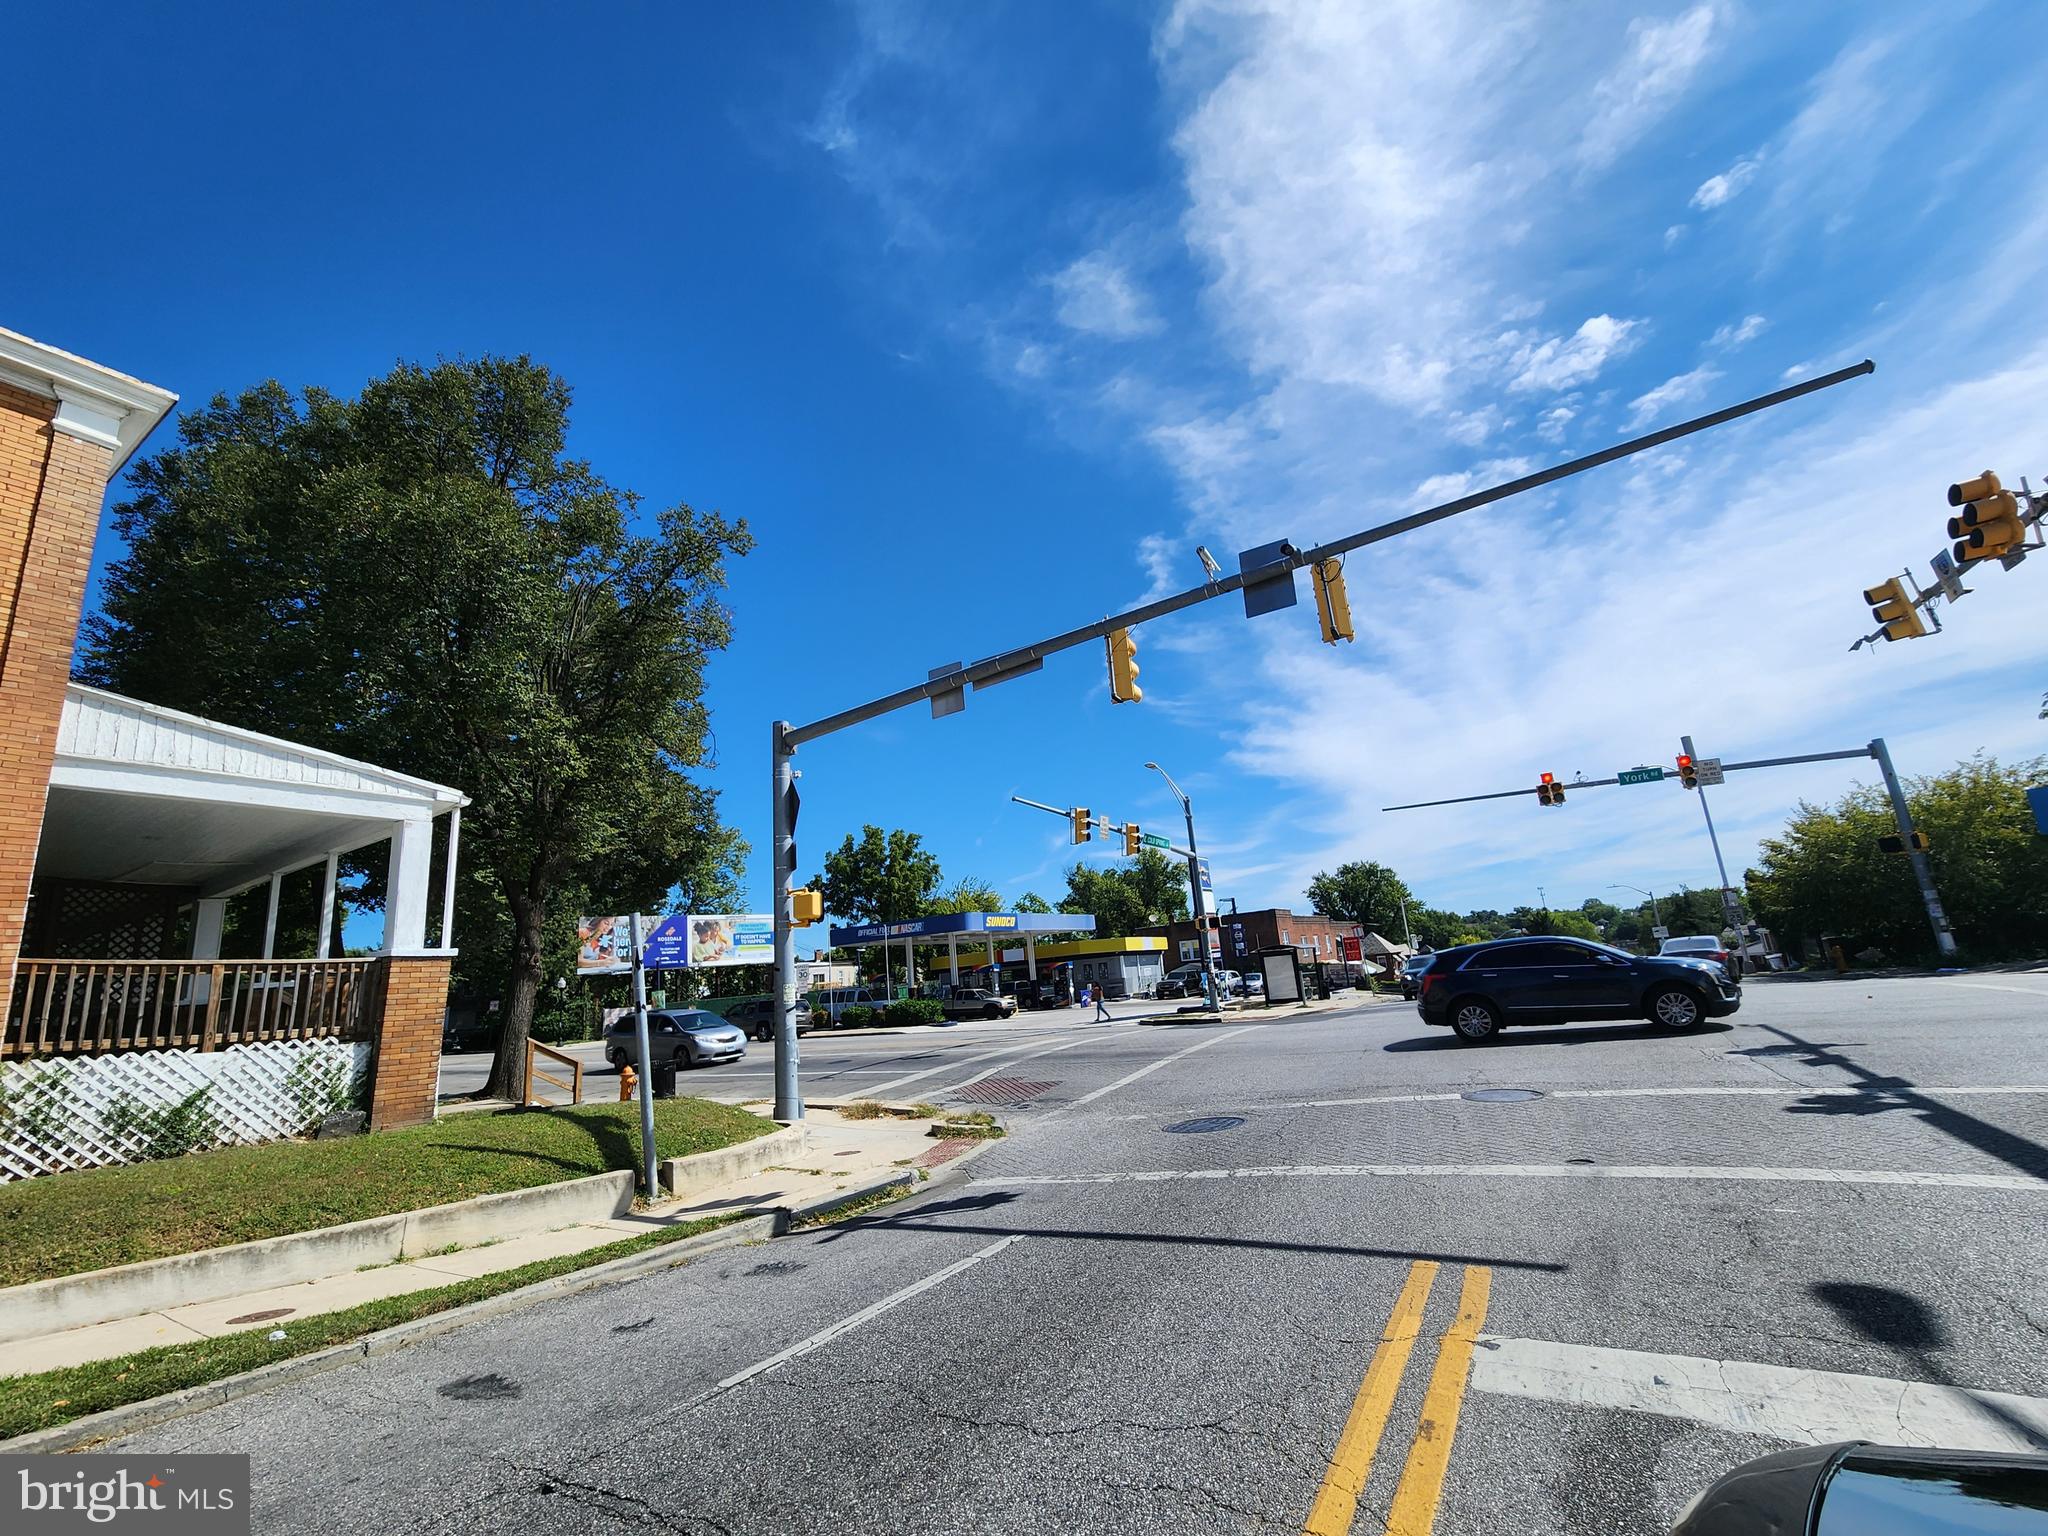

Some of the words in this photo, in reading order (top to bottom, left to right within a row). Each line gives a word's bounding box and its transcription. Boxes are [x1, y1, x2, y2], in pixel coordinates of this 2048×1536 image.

[1623, 772, 1649, 783] York
[986, 916, 1016, 927] SUNOCO
[857, 927, 878, 937] OFFICIAL
[799, 971, 808, 979] 30
